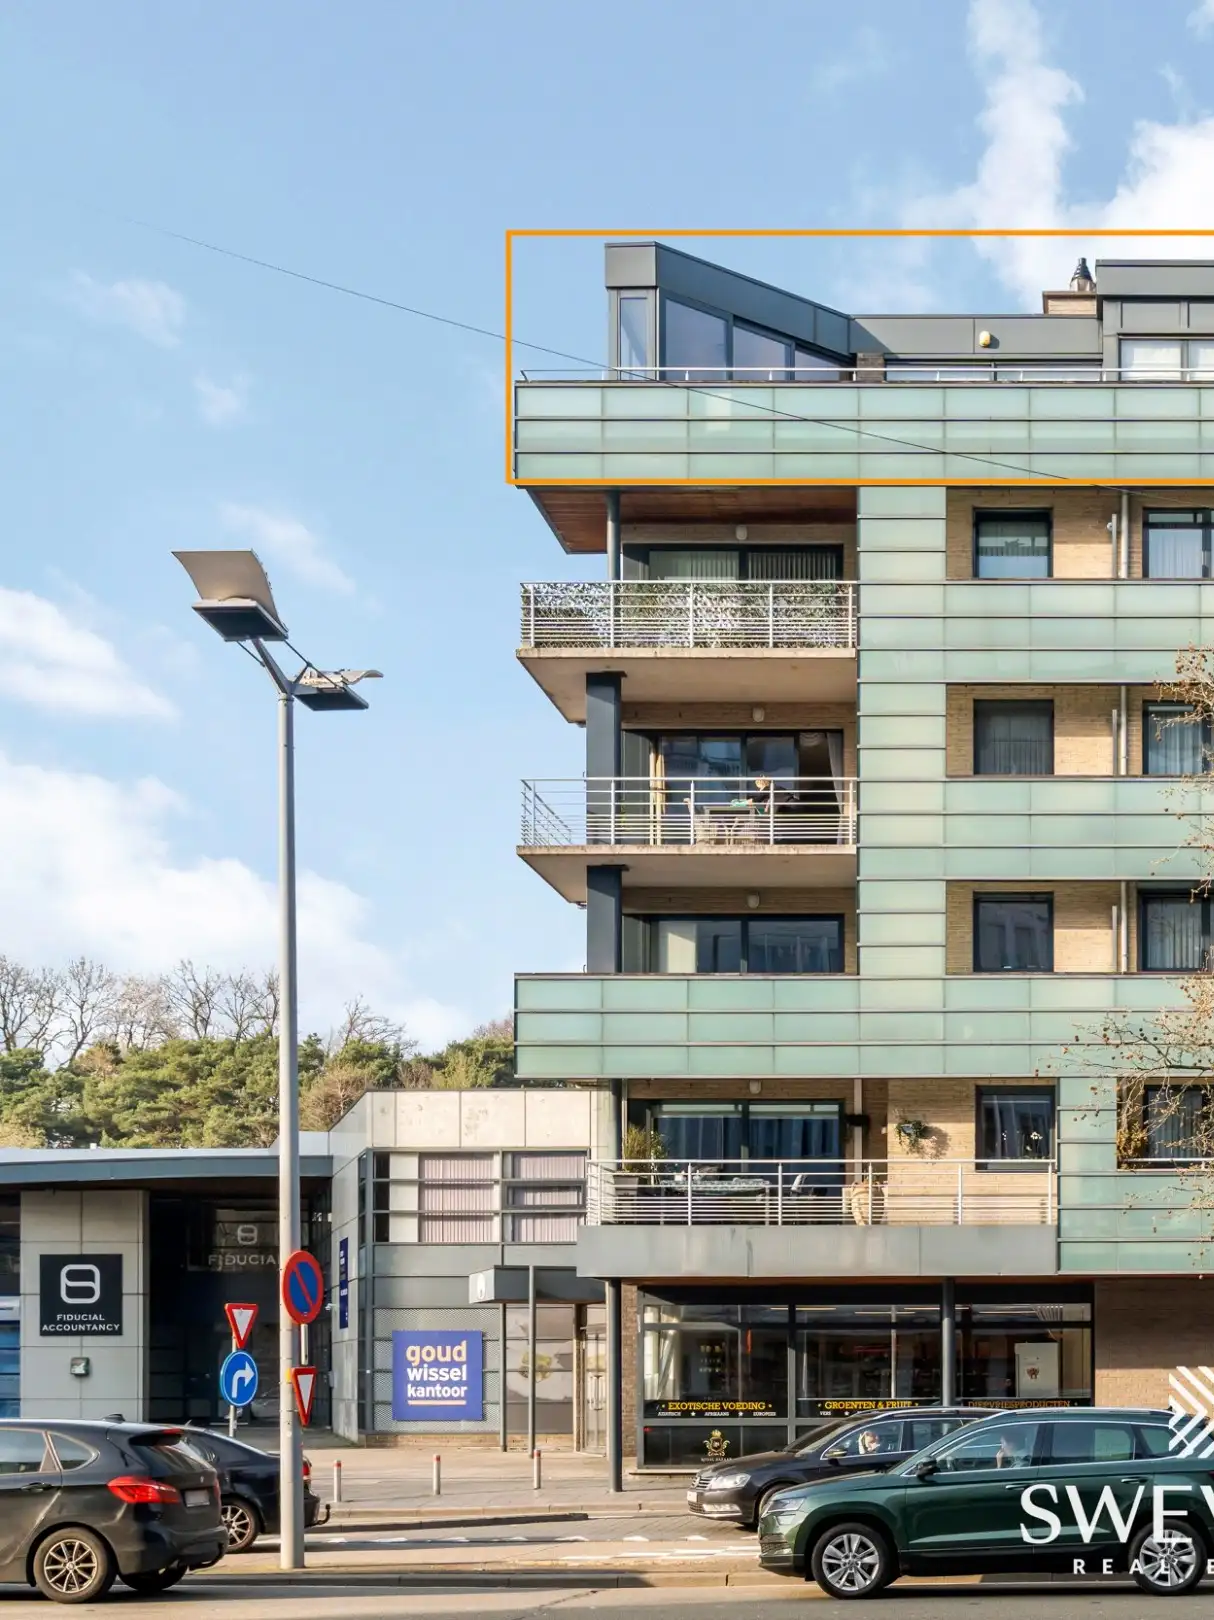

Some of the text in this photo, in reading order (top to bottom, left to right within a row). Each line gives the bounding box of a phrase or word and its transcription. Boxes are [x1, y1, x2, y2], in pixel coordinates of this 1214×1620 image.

[208, 1254, 280, 1266] FIDUCIA
[56, 1313, 105, 1321] FIDUCIAL
[42, 1323, 120, 1332] ACCOUNTANCY
[405, 1340, 467, 1367] goud
[406, 1363, 467, 1381] wissel
[407, 1383, 468, 1398] kantoor
[668, 1401, 766, 1411] EXOTISCHE VOEDING
[824, 1401, 876, 1410] GROENTEN
